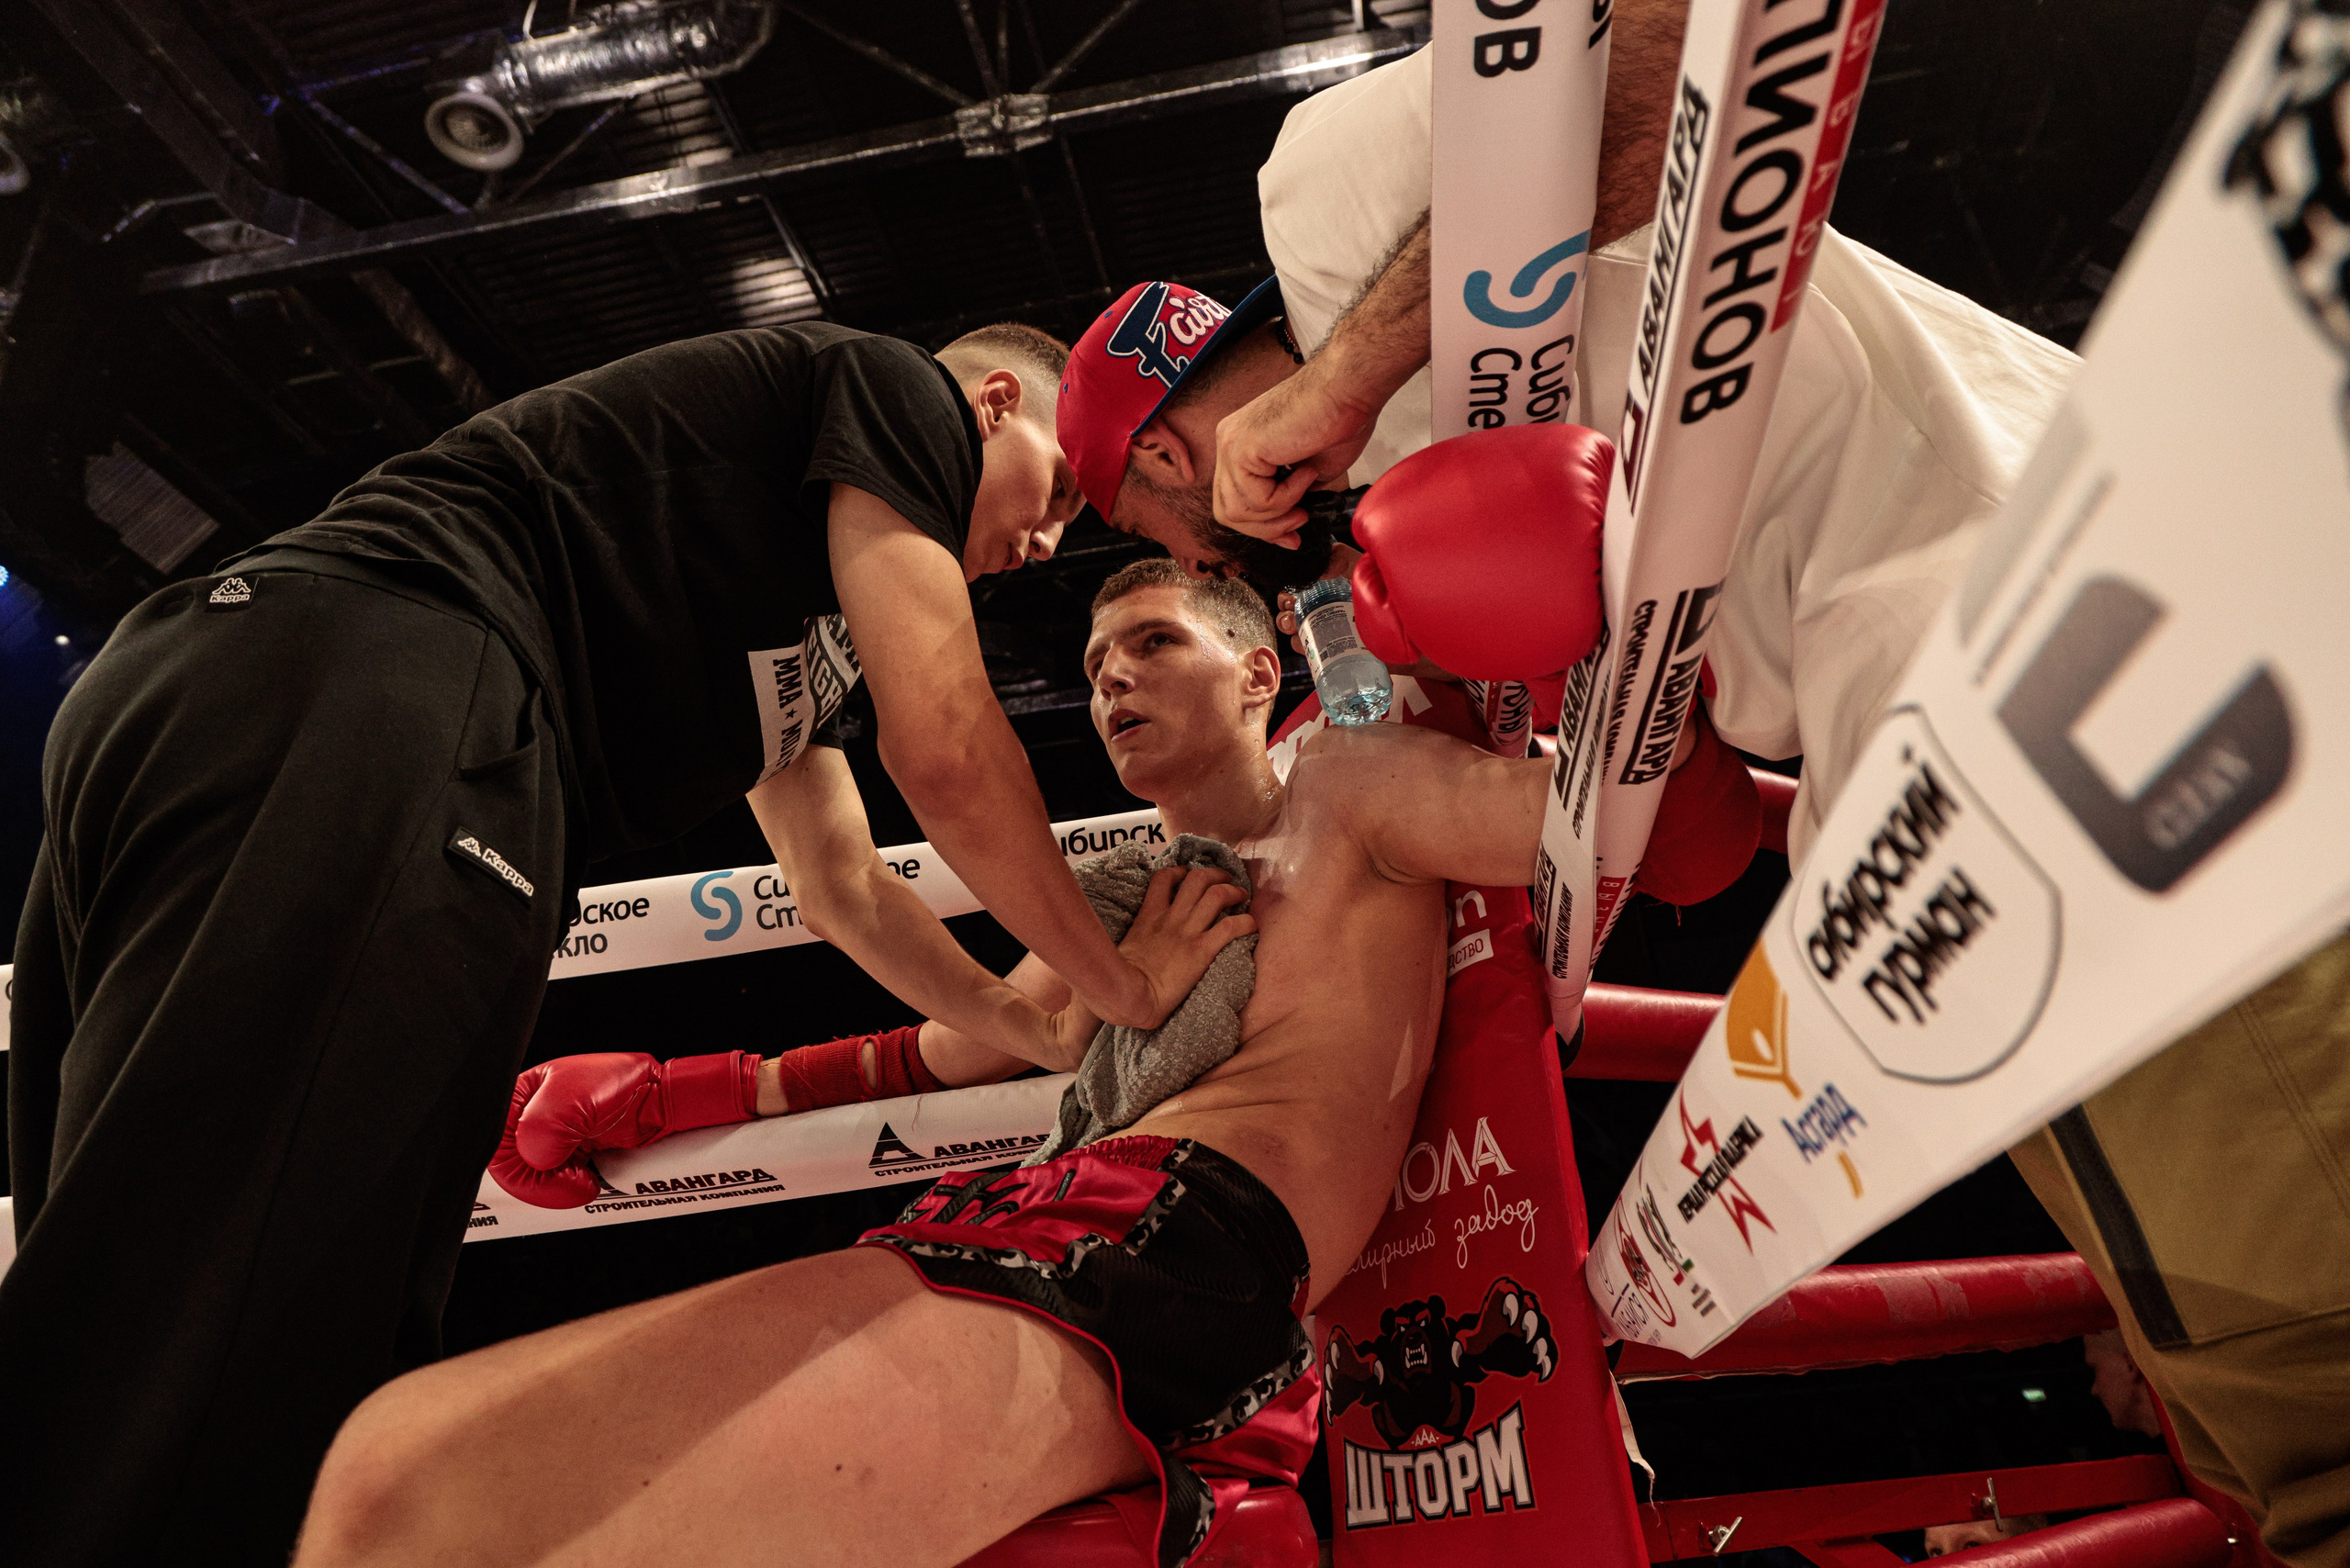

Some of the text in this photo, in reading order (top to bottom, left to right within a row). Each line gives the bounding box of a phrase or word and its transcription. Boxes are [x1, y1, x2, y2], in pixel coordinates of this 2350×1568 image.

[209, 593, 251, 604] Kappa
[773, 653, 803, 709] MMA
[1625, 653, 1703, 785] АВАНГАРД
[482, 847, 534, 897] Kappa
[569, 897, 650, 927] ское
[552, 933, 608, 960] кло
[1863, 866, 1999, 1024] гурман
[635, 1168, 778, 1195] АВАНГАРД
[874, 1155, 993, 1177] СТРОИТЕЛЬНАЯ
[584, 1184, 786, 1215] СТРОИТЕЛЬНАЯ КОМПАНИЯ
[1345, 1404, 1534, 1530] ШТОРМ
